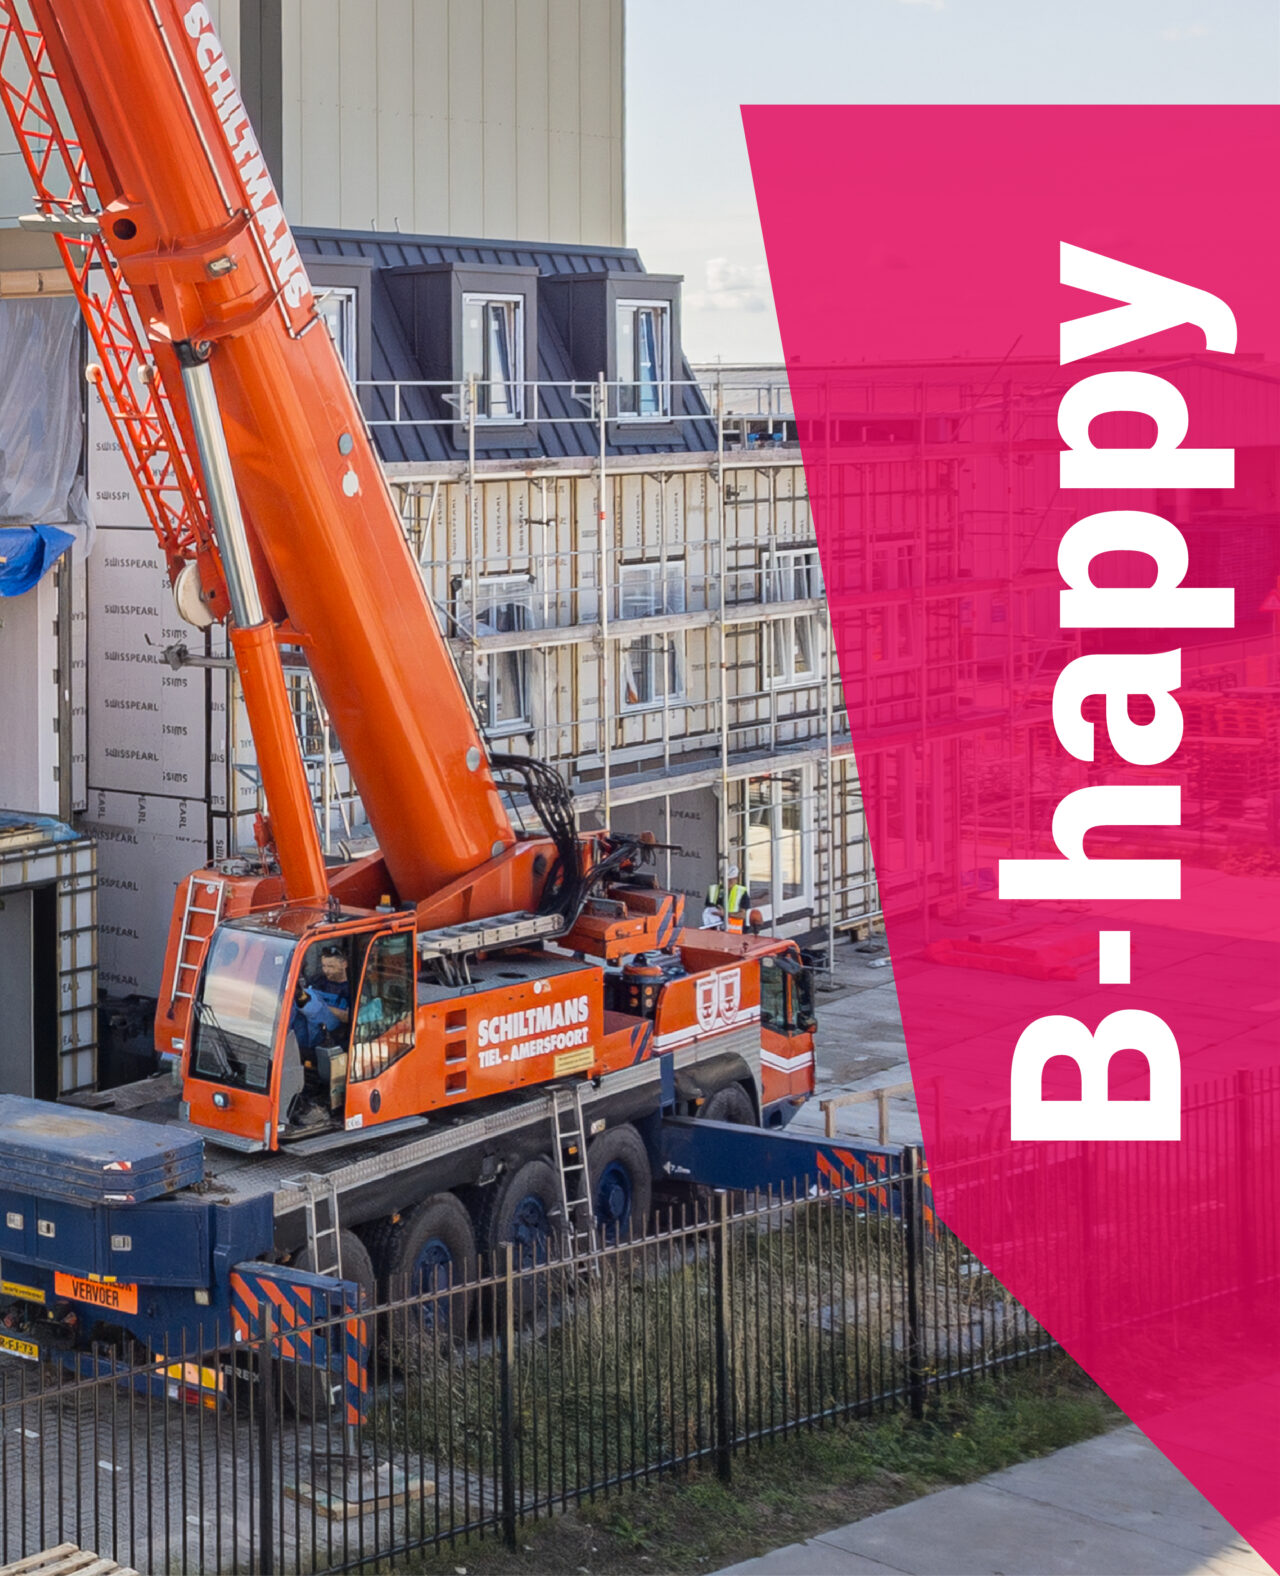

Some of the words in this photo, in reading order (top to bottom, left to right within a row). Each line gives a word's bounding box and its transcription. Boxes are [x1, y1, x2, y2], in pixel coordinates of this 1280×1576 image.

[184, 1, 310, 308] SCHILTMANS
[105, 558, 158, 569] SWISSPEARL
[105, 605, 159, 616] SWISSPEARL
[105, 651, 158, 664] SWISSPEARL
[105, 699, 159, 711] SWISSPEARL
[105, 748, 159, 761] SWISSPEARL
[478, 995, 588, 1047] SCHILTMANS
[72, 1280, 119, 1308] VERVOER
